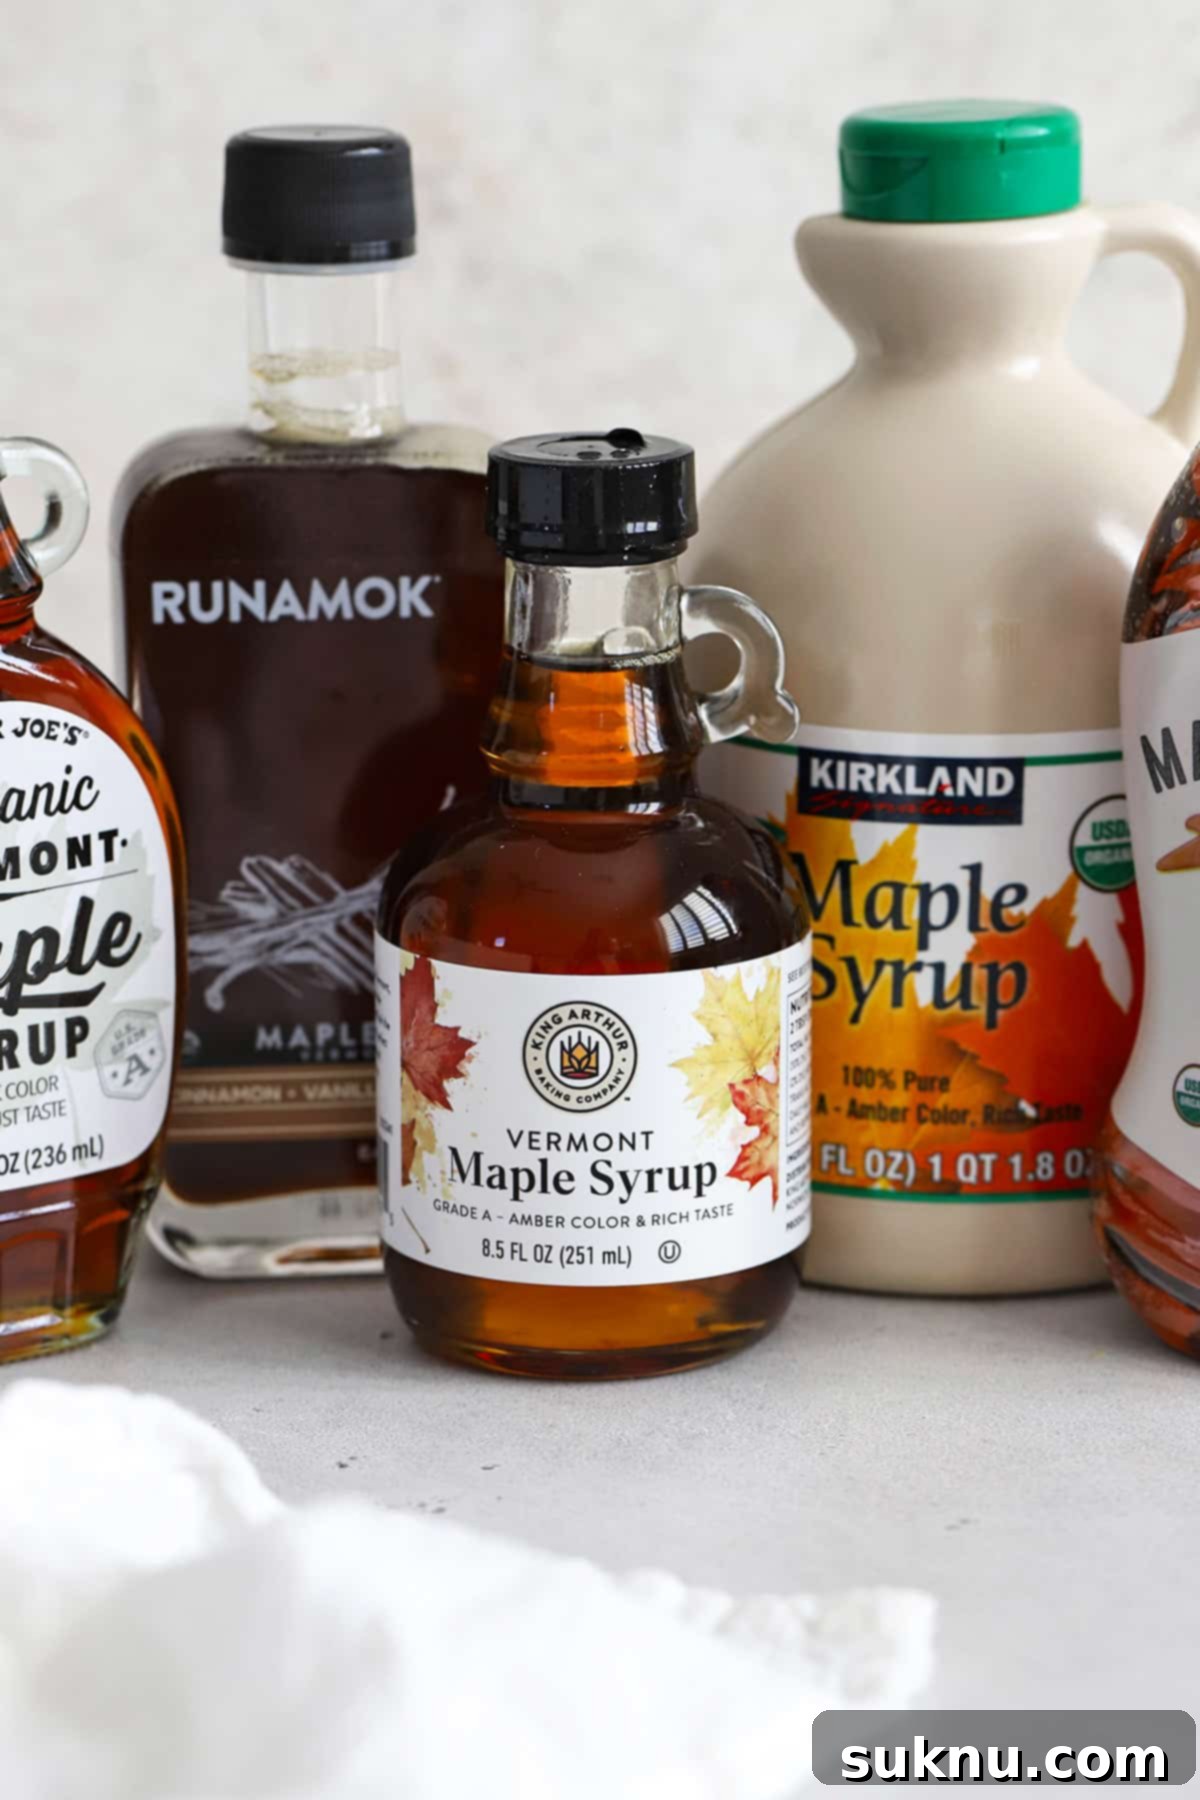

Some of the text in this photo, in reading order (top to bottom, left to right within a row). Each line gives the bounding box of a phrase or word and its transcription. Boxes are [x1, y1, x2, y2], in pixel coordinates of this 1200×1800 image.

[151, 576, 435, 624] RUNAMOK
[809, 757, 1015, 799] KIRKLAND
[790, 852, 1029, 951] Maple
[0, 895, 142, 1016] ple
[811, 932, 1028, 1031] Syrup
[256, 1021, 376, 1050] MAPLE
[530, 1008, 629, 1052] KING ARTHUR
[5, 1074, 59, 1100] COLOR
[122, 1053, 152, 1087] A
[534, 1067, 625, 1104] BAKING COMPANY
[842, 1064, 950, 1093] 100% Pure
[24, 1099, 67, 1123] TASTE
[815, 1093, 828, 1115] A
[847, 1098, 909, 1123] Amber
[24, 1143, 68, 1176] (236
[72, 1133, 104, 1161] mL)
[506, 1128, 655, 1153] VERMONT
[448, 1145, 717, 1205] Maple Syrup
[820, 1143, 856, 1176] FL
[863, 1147, 917, 1188] OZ)
[928, 1151, 943, 1184] 1
[955, 1151, 999, 1185] QT
[1008, 1150, 1056, 1183] 1.8
[432, 1198, 479, 1220] GRADE
[481, 1209, 493, 1222] A
[508, 1212, 566, 1229] AMBER
[570, 1215, 631, 1229] COLOR
[635, 1214, 646, 1228] &
[651, 1210, 690, 1227] RICH
[694, 1203, 735, 1221] TASTE
[481, 1237, 633, 1269] 8.5 FL OZ (251 mL)
